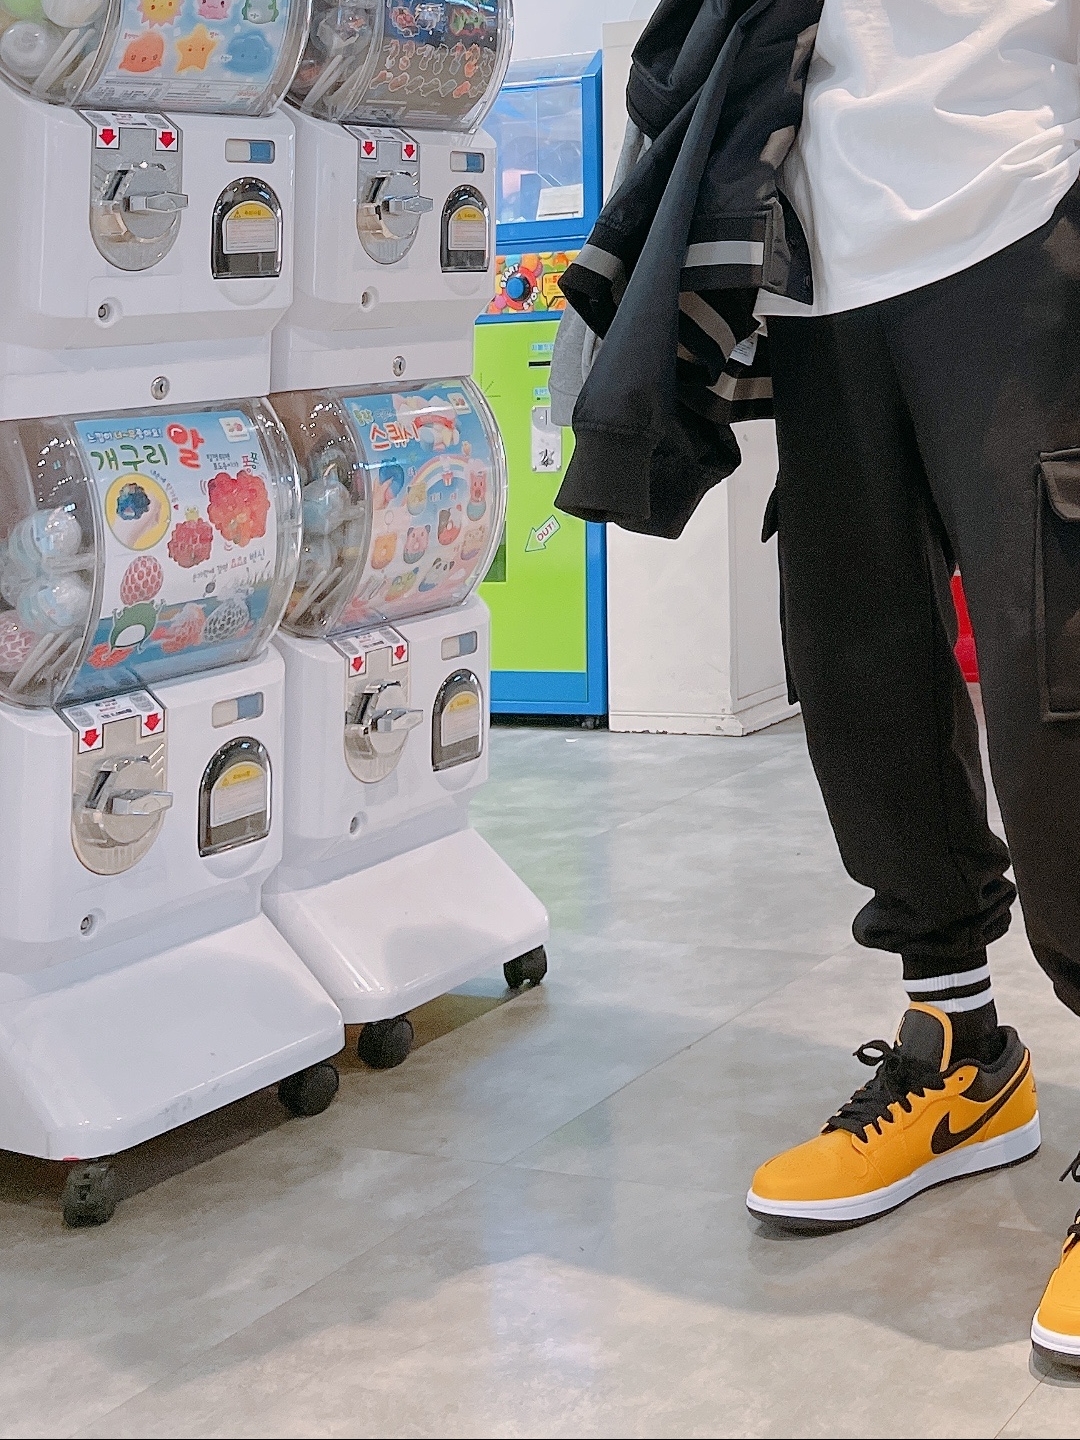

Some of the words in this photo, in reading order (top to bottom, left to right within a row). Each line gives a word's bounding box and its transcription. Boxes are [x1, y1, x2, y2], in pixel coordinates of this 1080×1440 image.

[500, 263, 519, 288] START
[523, 286, 540, 310] STOP
[90, 444, 169, 471] 개구리
[166, 423, 205, 469] 알
[536, 521, 555, 542] OUT!
